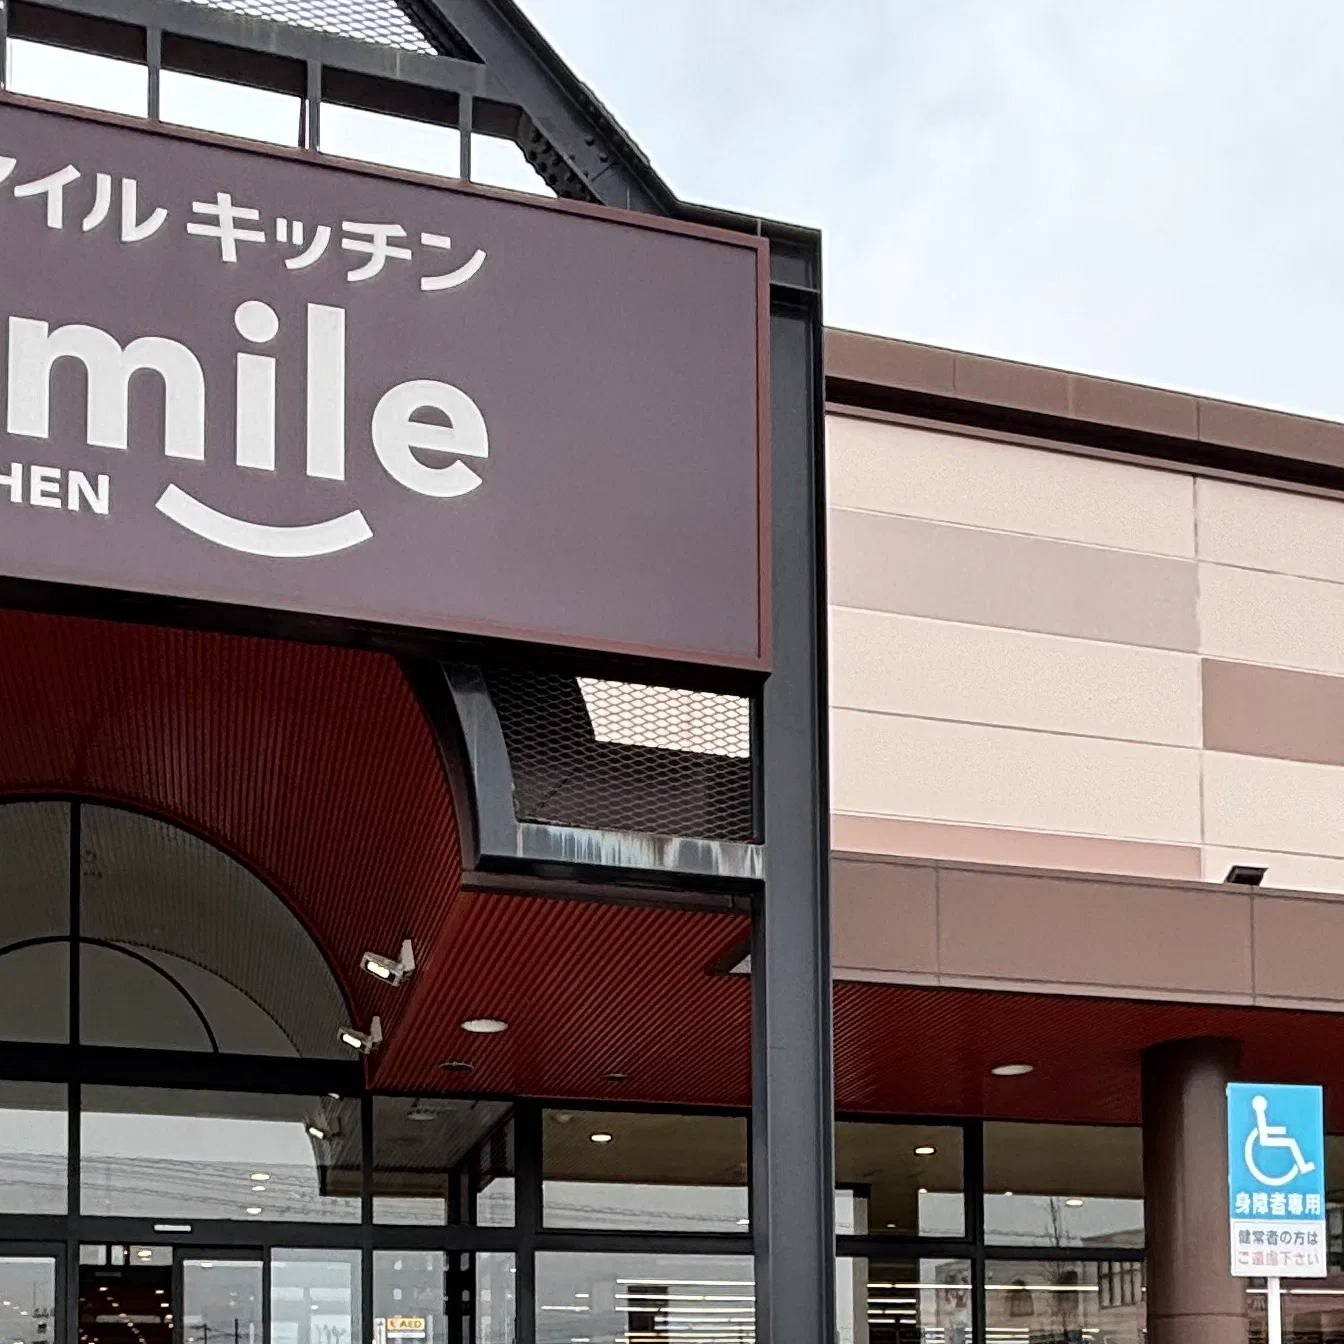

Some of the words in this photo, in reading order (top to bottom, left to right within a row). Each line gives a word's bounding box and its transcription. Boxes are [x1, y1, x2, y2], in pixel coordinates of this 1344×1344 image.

[186, 192, 487, 291] キッチン
[1236, 1192, 1321, 1215] 身障者専用
[1238, 1229, 1318, 1245] 健常者の方は
[400, 1320, 422, 1328] AED
